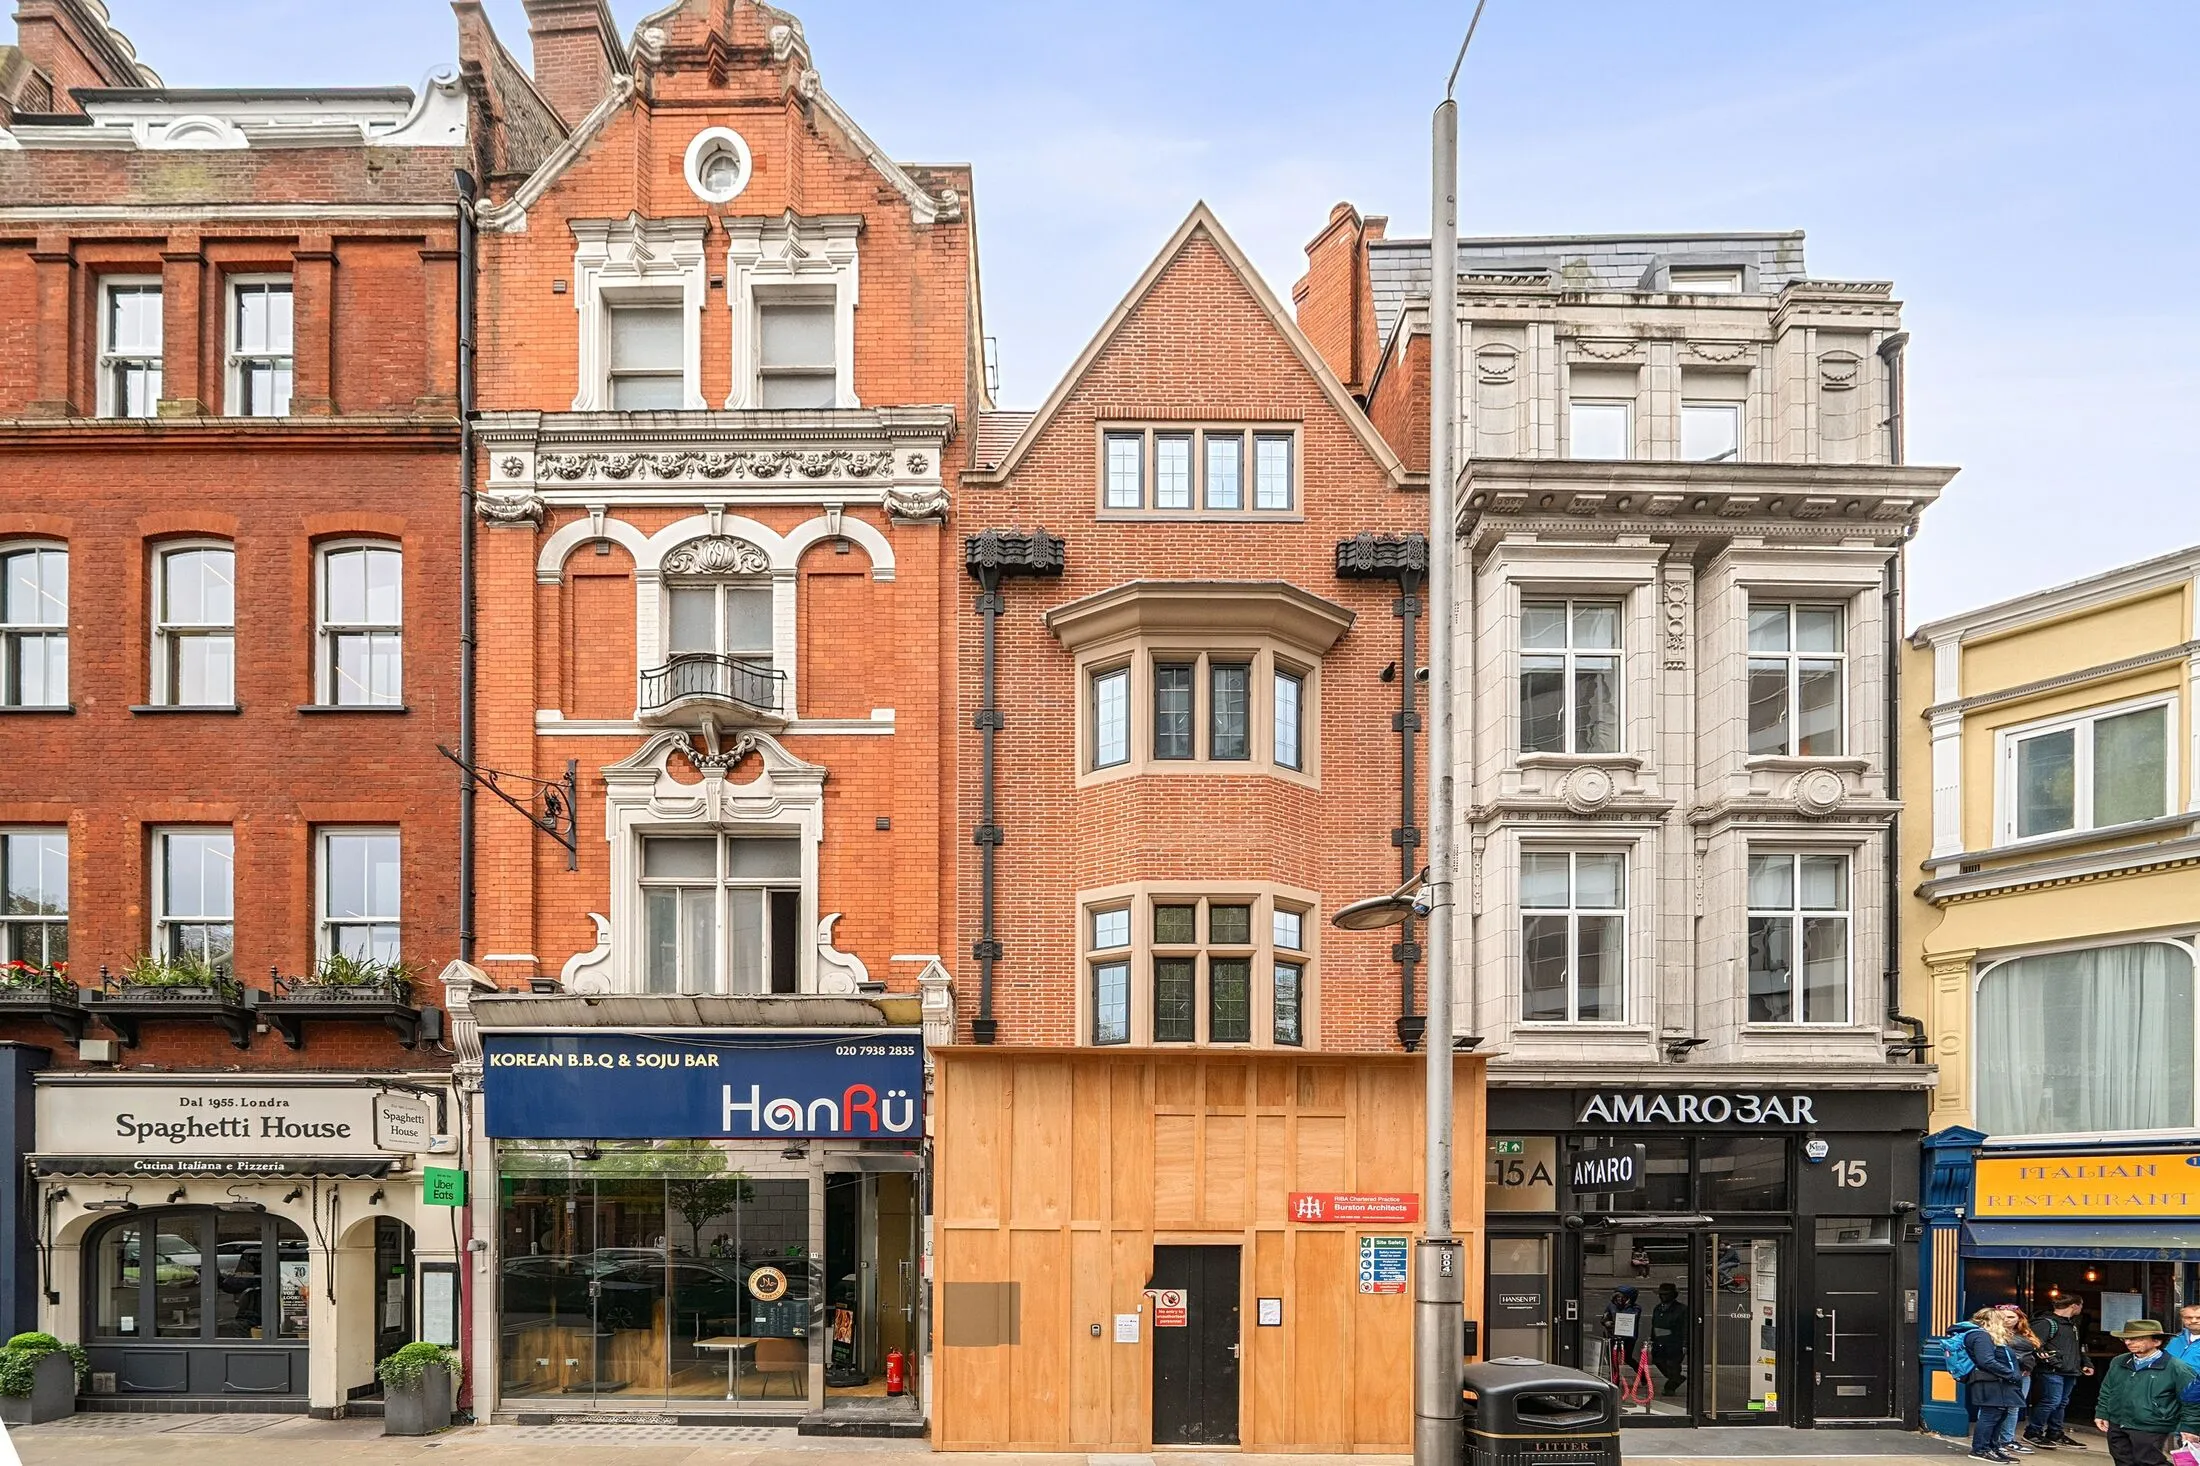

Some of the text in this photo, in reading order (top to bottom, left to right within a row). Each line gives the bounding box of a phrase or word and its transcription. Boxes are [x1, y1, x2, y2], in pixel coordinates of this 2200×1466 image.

[836, 1046, 915, 1056] 020 7938 2835
[490, 1053, 720, 1069] KOREAN B.B.Q & SOJU BAR
[179, 1097, 202, 1107] Dal
[722, 1083, 914, 1133] HanRü
[1577, 1094, 1731, 1123] AMARO
[383, 1108, 424, 1124] Spaghetti
[116, 1113, 351, 1144] Spaghetti House
[390, 1125, 419, 1137] House
[133, 1160, 174, 1170] Cucina
[177, 1160, 222, 1170] Italiana
[237, 1161, 285, 1171] Pizzeria
[1494, 1159, 1553, 1186] 15A
[1574, 1156, 1633, 1185] AMARO
[2020, 1163, 2158, 1180] ITALIAN
[1831, 1160, 1868, 1187] 15
[433, 1178, 454, 1190] Uber
[433, 1189, 454, 1200] Eats
[1987, 1192, 2195, 1207] RESTAURANT
[1334, 1203, 1365, 1211] Burston
[2018, 1247, 2070, 1258] 0207
[1535, 1442, 1590, 1451] LITTER
